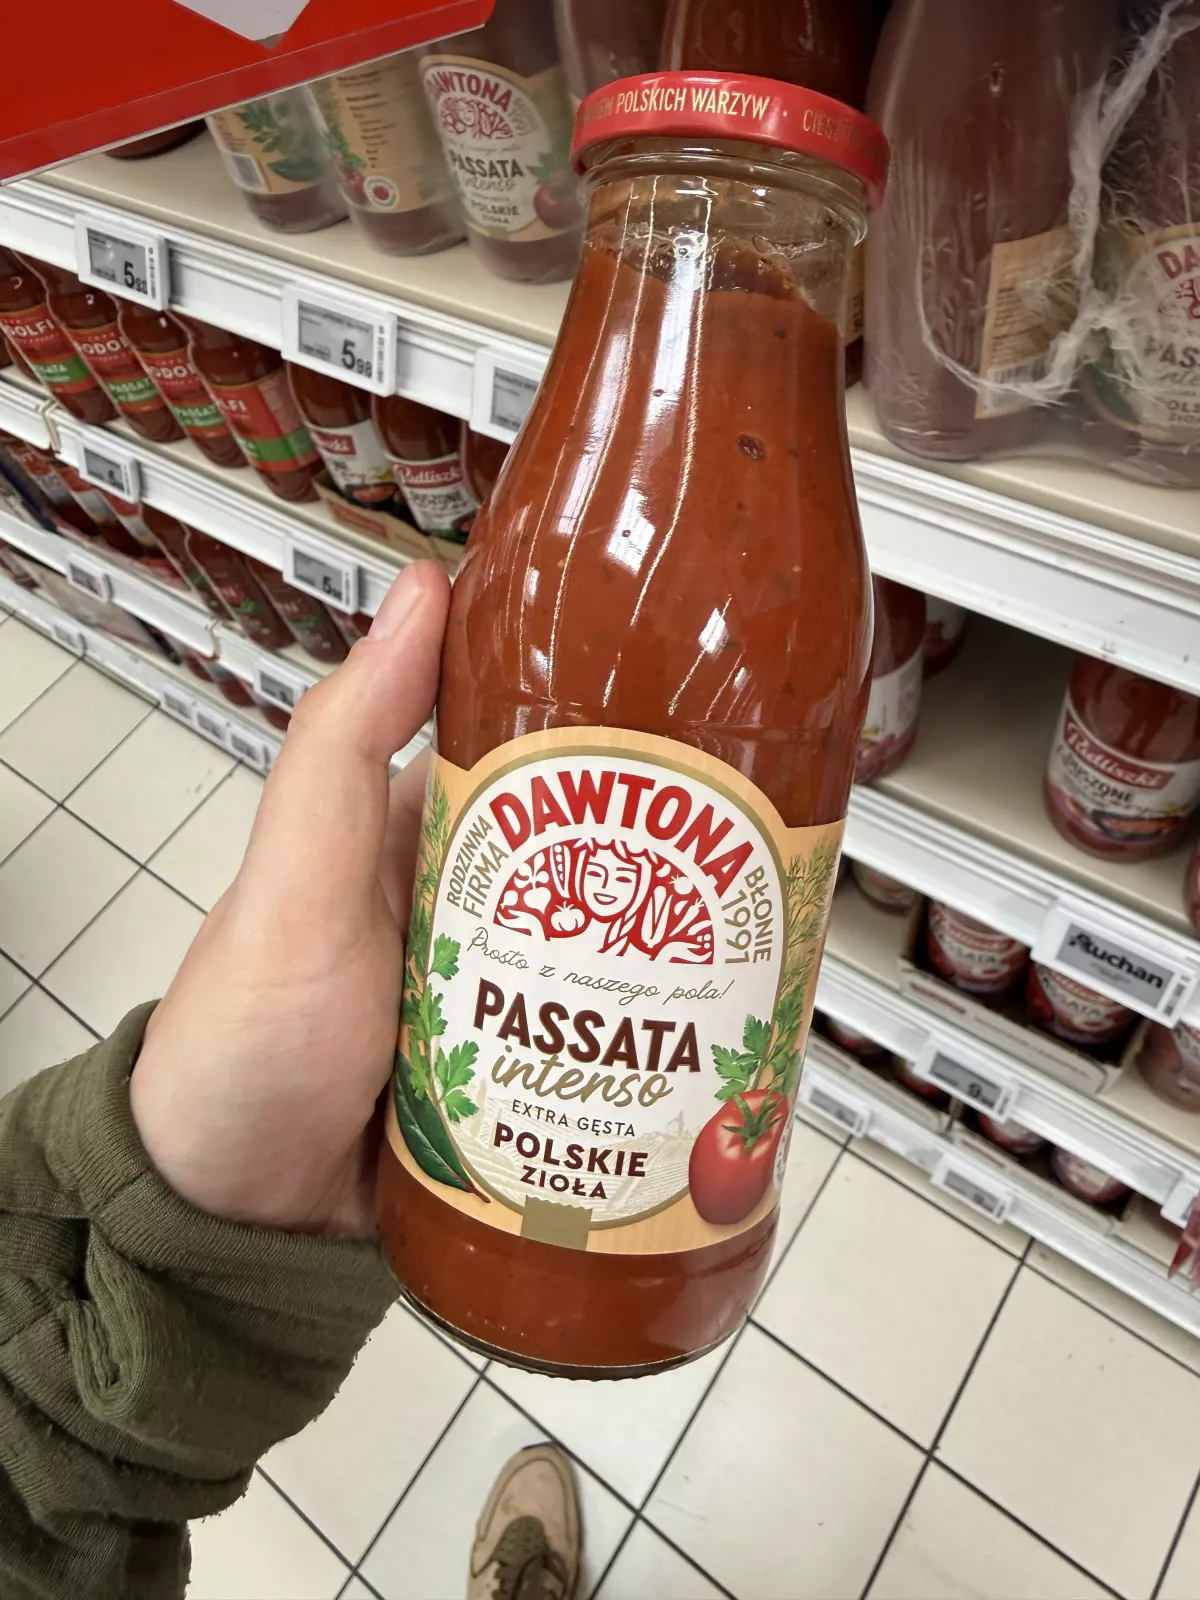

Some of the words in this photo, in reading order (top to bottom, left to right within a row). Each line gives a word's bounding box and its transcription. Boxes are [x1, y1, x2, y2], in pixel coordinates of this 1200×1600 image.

[616, 87, 687, 115] POLSKICH
[691, 86, 770, 121] WARZYW
[446, 814, 494, 908] RODZINNA
[488, 769, 755, 899] DAWTONA
[462, 840, 510, 919] FIRMA
[743, 864, 774, 964] BŁONIE
[720, 888, 752, 964] 1991
[1068, 932, 1164, 989] Auchan
[466, 926, 530, 970] Prosto
[538, 964, 556, 978] z
[563, 971, 661, 1006] naszego
[662, 978, 736, 1006] pola!
[472, 977, 702, 1073] PASSATA
[491, 1044, 674, 1108] intenso
[493, 1121, 649, 1178] POLSKIE
[511, 1098, 570, 1128] EXTRA
[577, 1116, 636, 1137] GĘSTA
[519, 1164, 608, 1200] ZIOŁA
